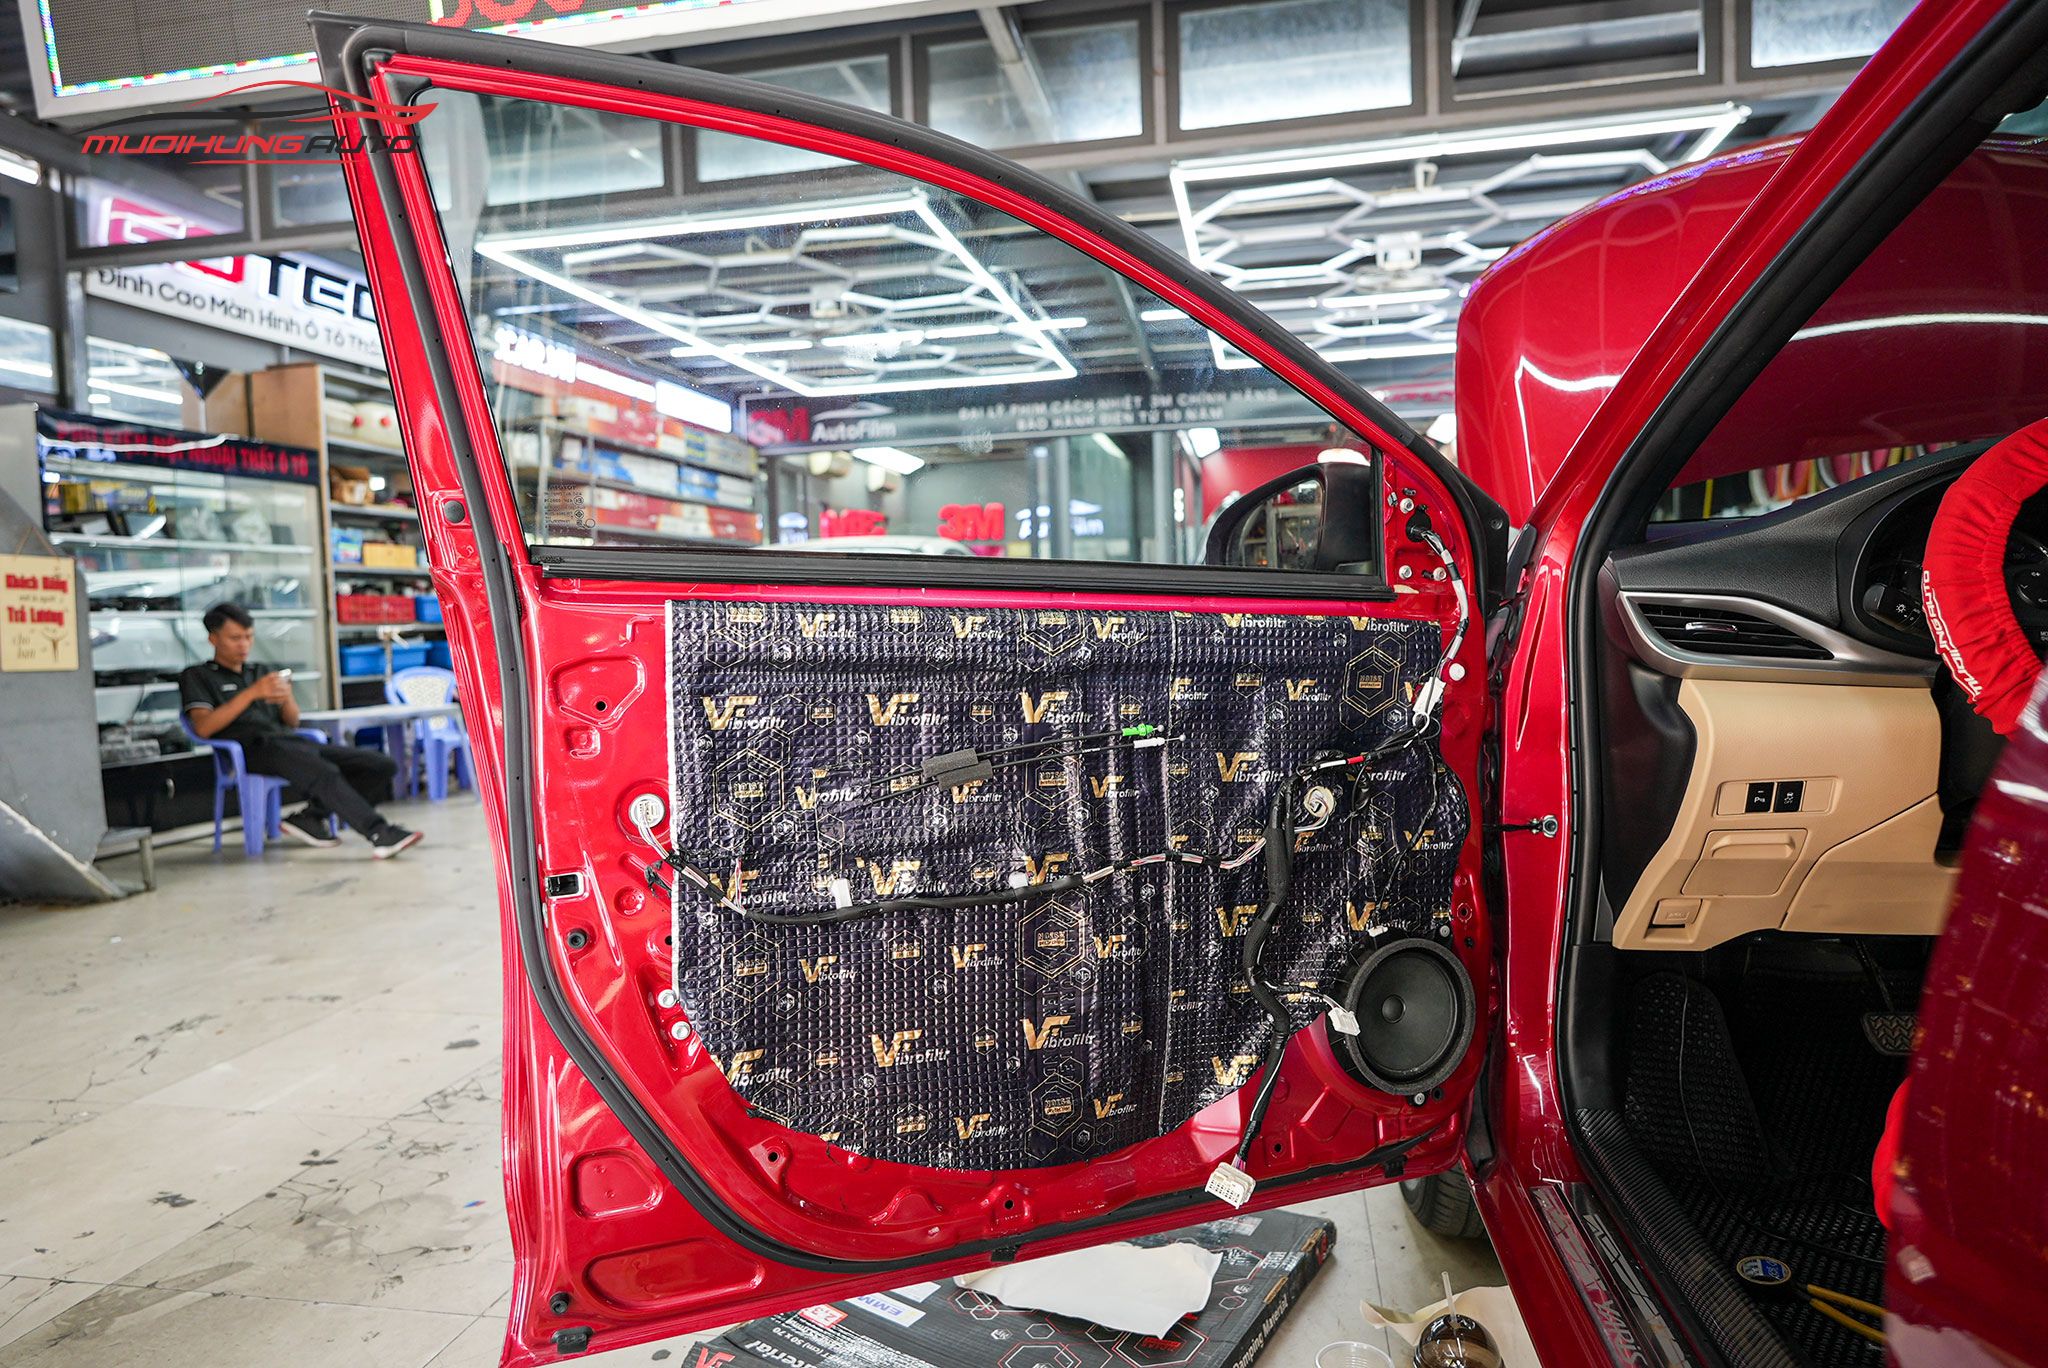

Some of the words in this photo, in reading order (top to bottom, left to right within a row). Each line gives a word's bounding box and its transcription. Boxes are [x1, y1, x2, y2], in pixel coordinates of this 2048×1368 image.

[159, 283, 206, 310] Cao
[210, 295, 255, 323] Màn
[812, 419, 897, 443] AutoFilm
[938, 502, 1005, 541] 3M
[1262, 1293, 1288, 1338] Material
